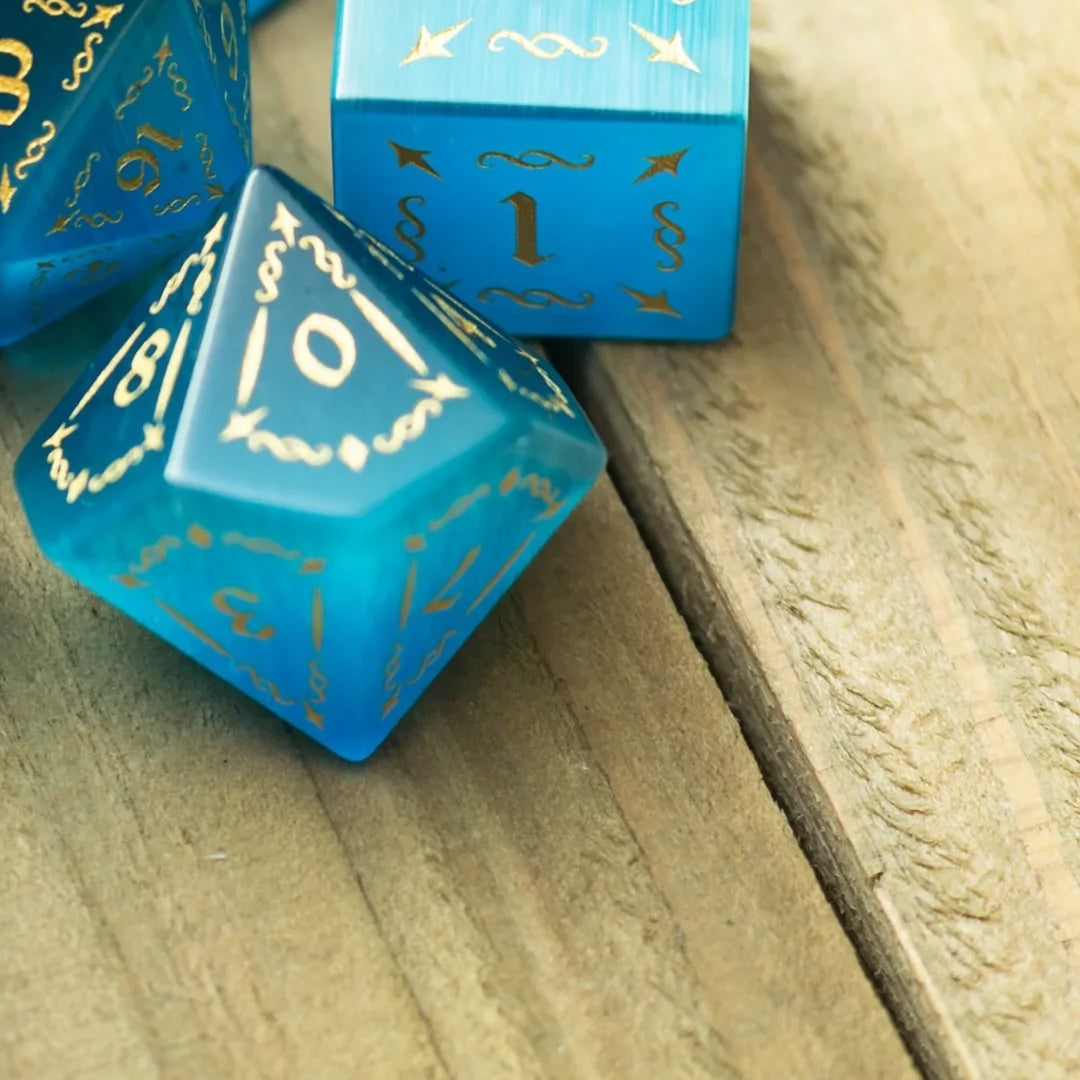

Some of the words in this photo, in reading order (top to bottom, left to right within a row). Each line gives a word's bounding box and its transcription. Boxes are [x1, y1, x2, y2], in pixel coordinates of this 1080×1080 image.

[115, 122, 184, 198] 16
[498, 190, 555, 268] 1
[113, 327, 170, 408] 8
[291, 312, 357, 388] 0
[211, 586, 276, 640] 3
[422, 545, 481, 615] 7
